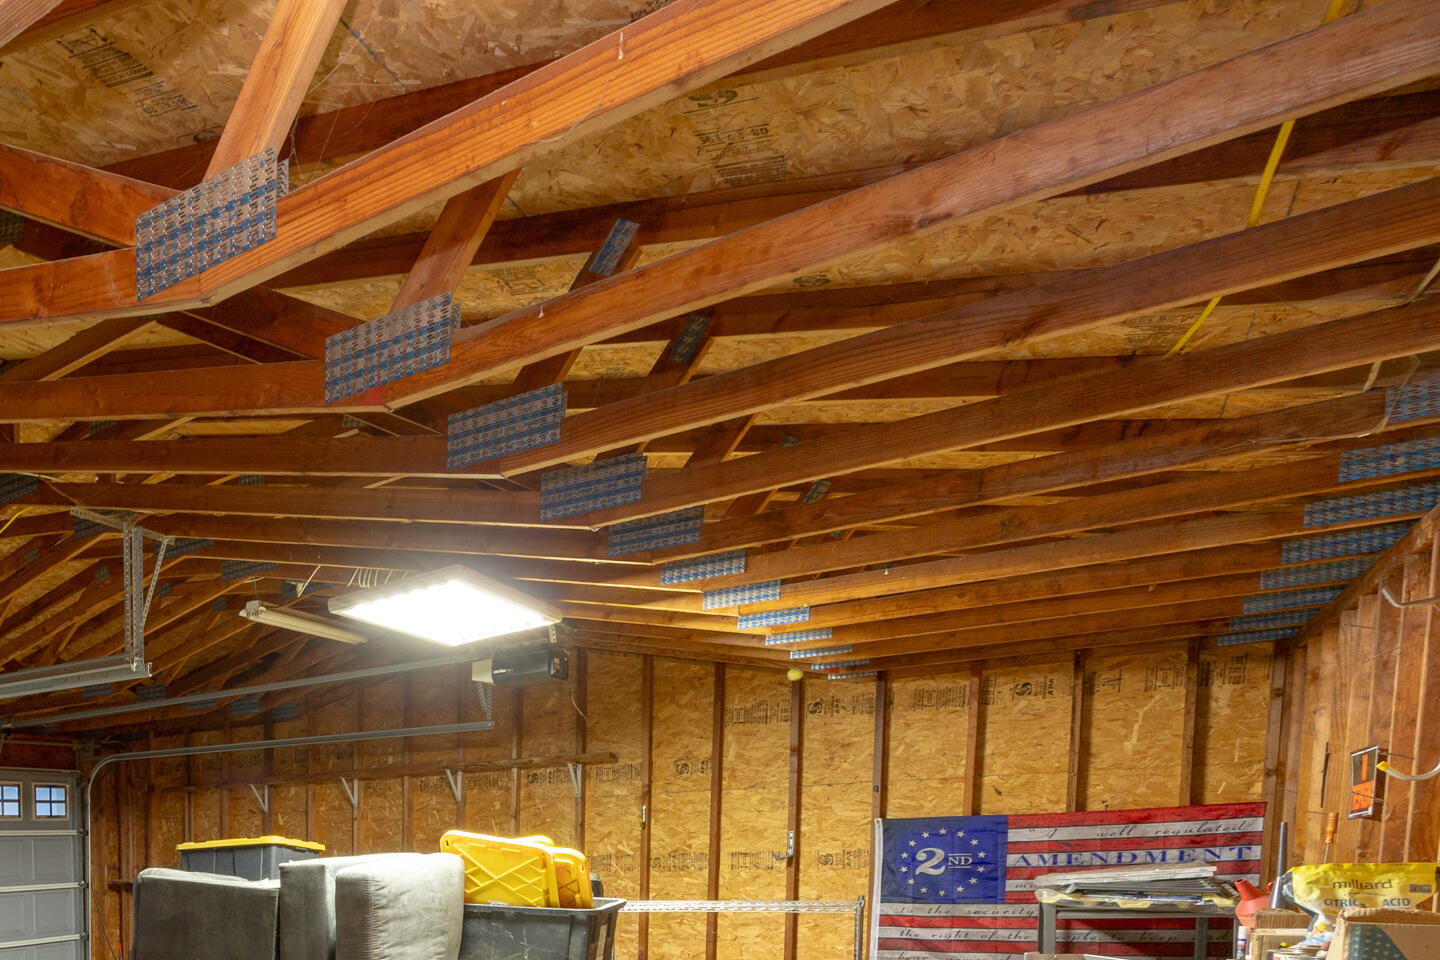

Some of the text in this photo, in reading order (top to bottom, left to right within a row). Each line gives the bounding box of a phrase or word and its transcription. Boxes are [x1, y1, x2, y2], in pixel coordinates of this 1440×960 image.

[1154, 820, 1247, 836] regulated
[915, 847, 974, 876] 2ND
[1013, 846, 1253, 868] AMENDMENT
[1333, 879, 1393, 890] milliard
[1323, 898, 1411, 908] CITRIC ACID
[927, 905, 952, 915] the
[967, 908, 1035, 917] security
[900, 929, 920, 938] the
[931, 930, 969, 941] right
[980, 930, 997, 941] of
[1008, 931, 1031, 941] the
